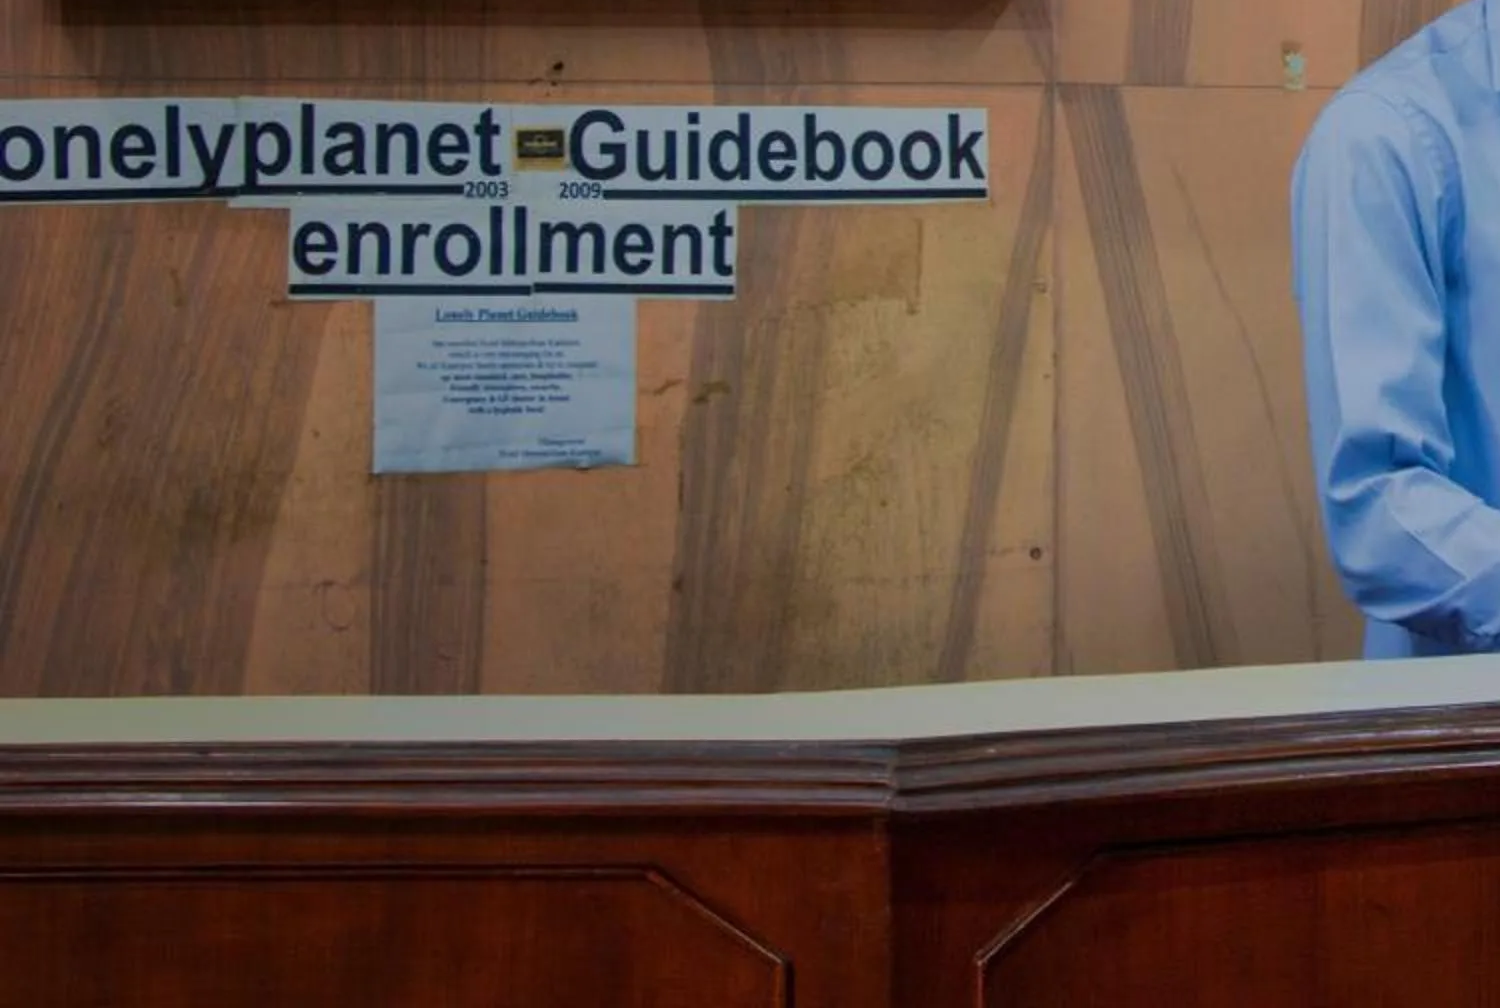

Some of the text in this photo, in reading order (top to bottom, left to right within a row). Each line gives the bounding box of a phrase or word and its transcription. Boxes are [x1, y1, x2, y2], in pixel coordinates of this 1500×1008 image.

[569, 109, 986, 181] Guidebook
[464, 181, 603, 199] 2003 2009
[292, 204, 735, 277] enrollment
